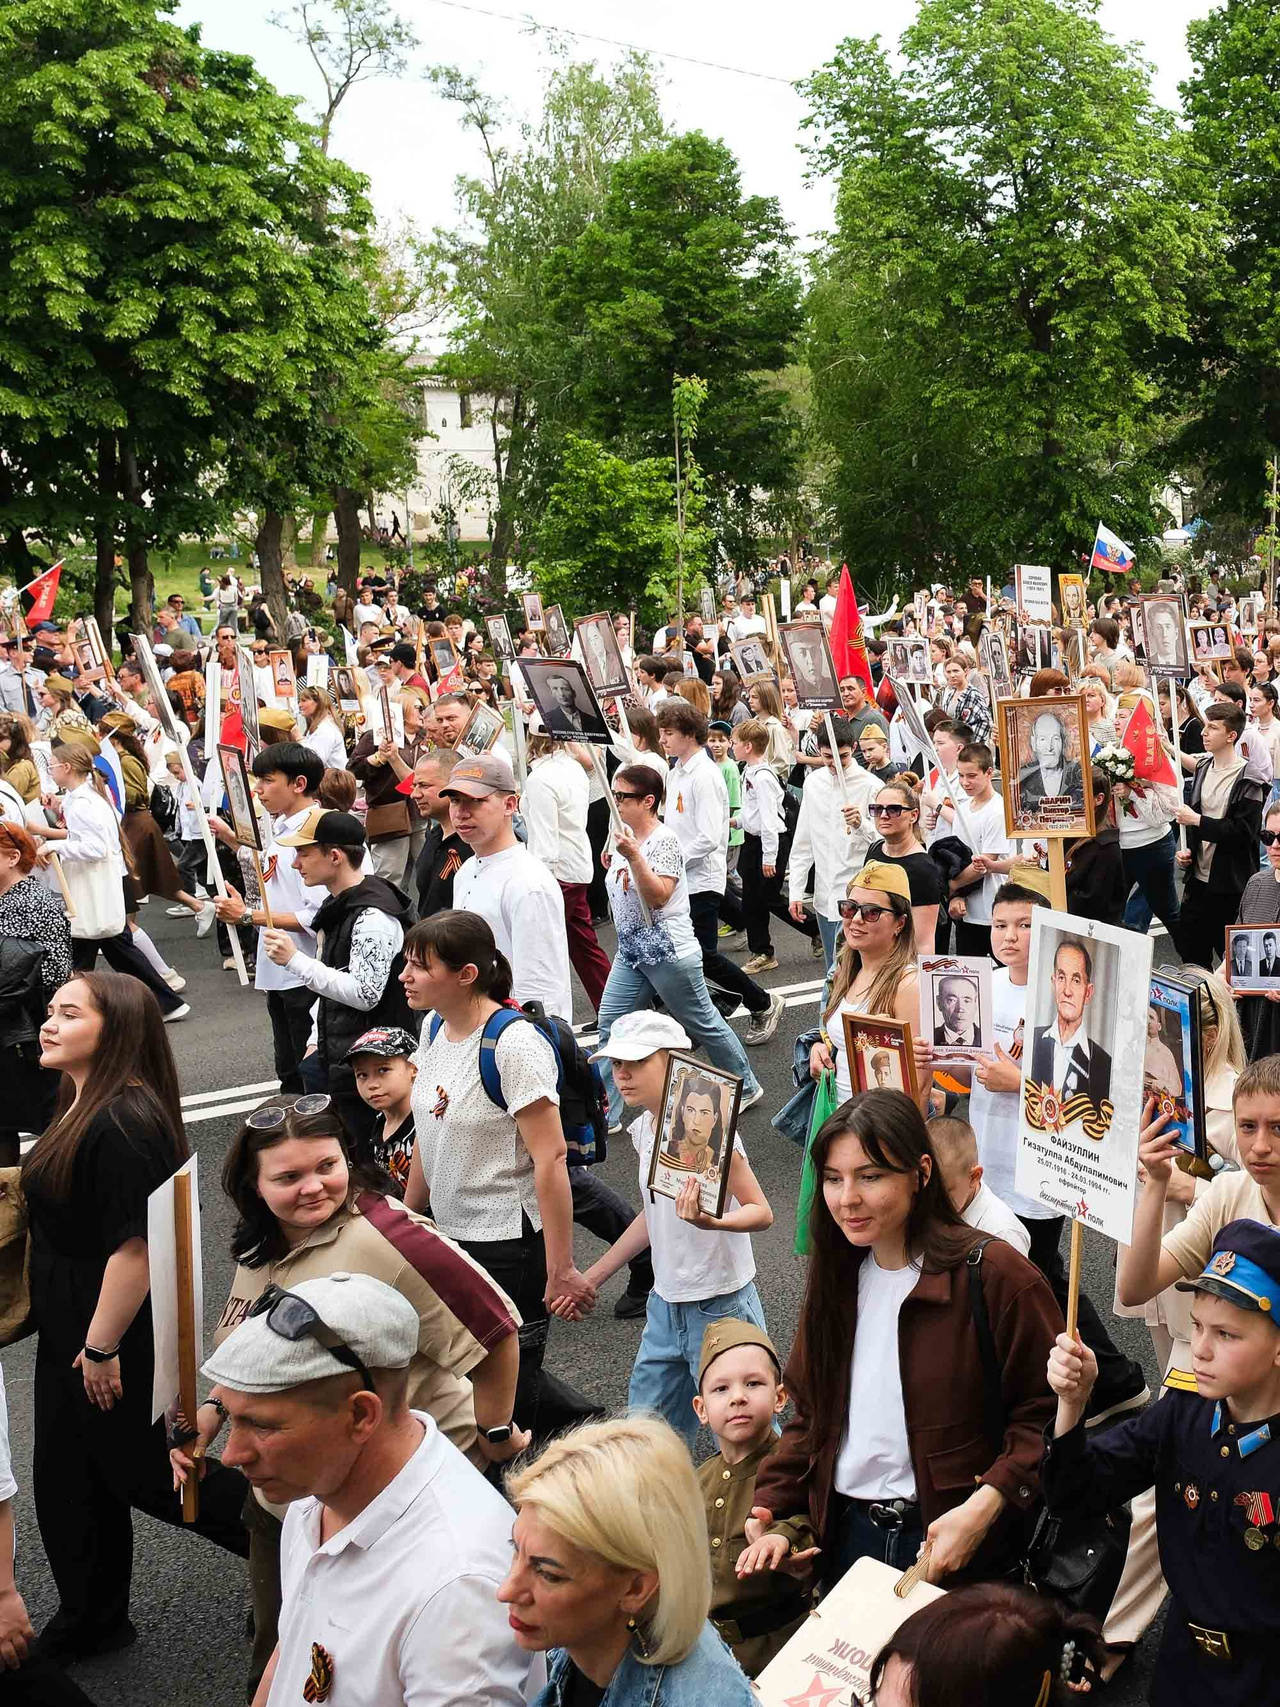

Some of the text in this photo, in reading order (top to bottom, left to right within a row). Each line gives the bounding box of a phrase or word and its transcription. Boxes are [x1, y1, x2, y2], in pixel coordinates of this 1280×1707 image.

[1042, 806, 1069, 815] Виктор
[1039, 816, 1075, 824] Петрович
[1162, 996, 1179, 1008] ПОЛК
[1050, 1135, 1100, 1163] ФАЙЗУЛЛИН
[1023, 1137, 1128, 1190] Гизатулла Абдулалимович
[1058, 1178, 1087, 1195] ефрейтор
[1087, 1214, 1104, 1228] ПОЛК
